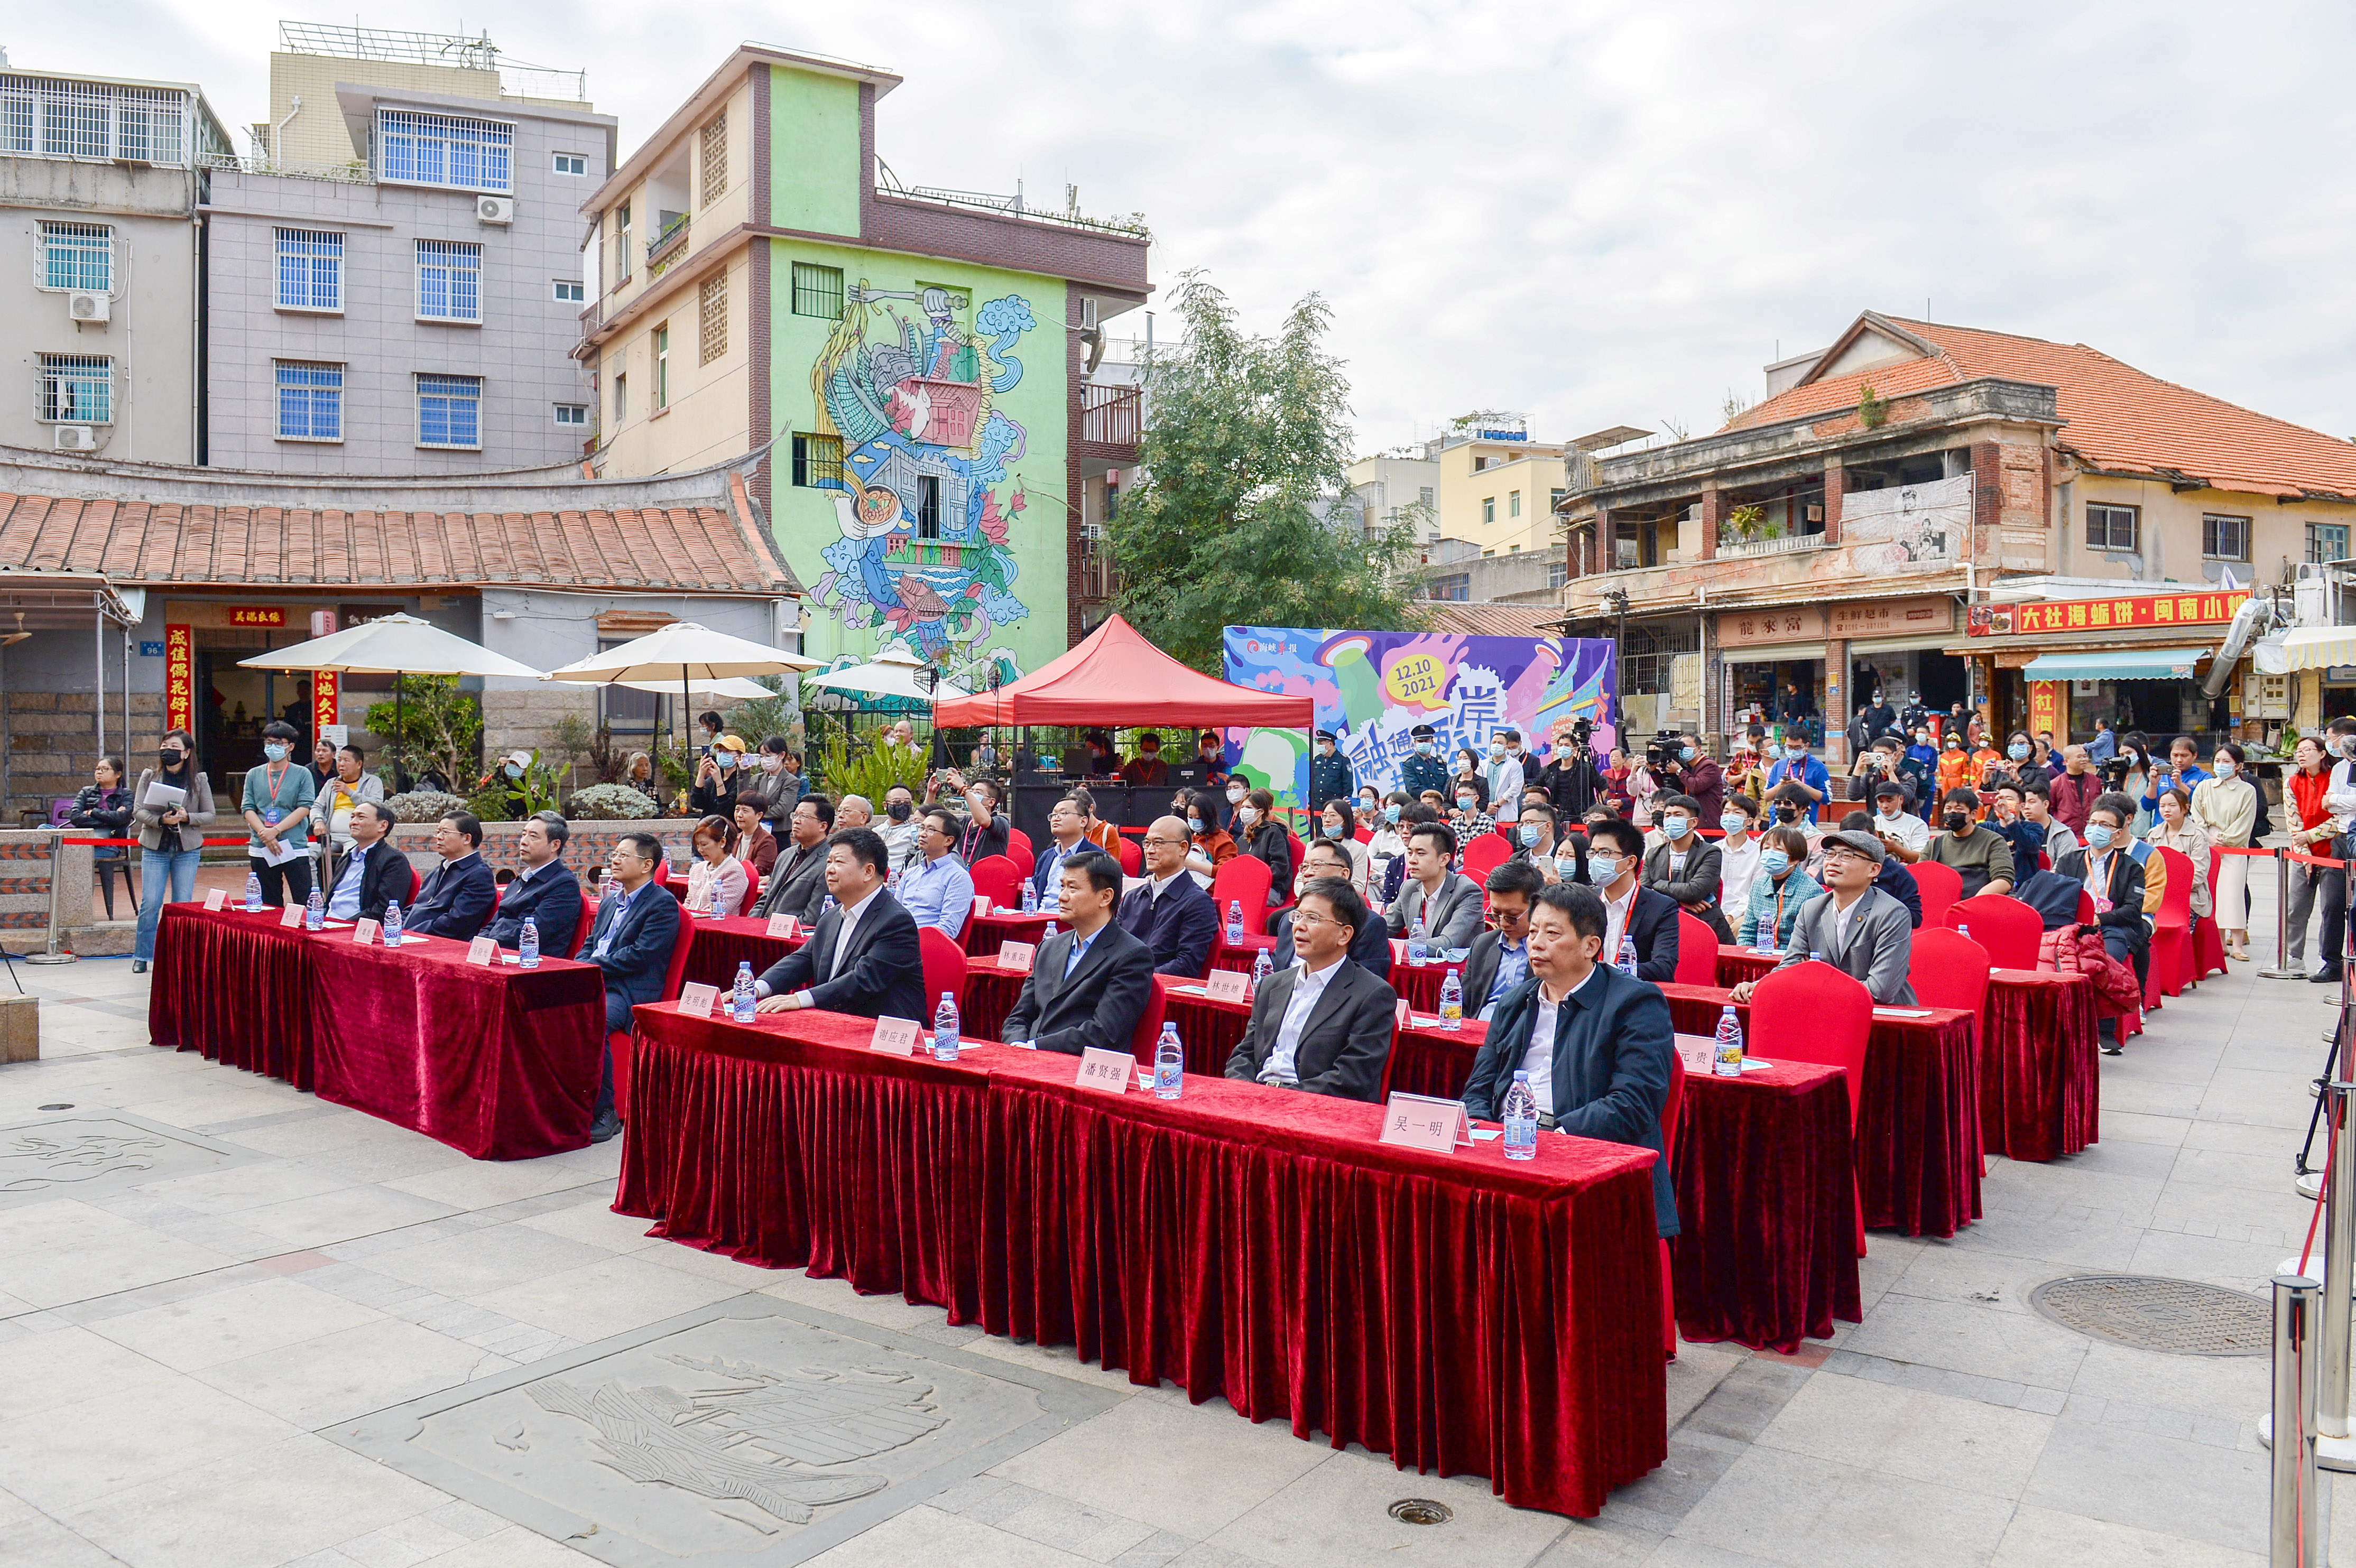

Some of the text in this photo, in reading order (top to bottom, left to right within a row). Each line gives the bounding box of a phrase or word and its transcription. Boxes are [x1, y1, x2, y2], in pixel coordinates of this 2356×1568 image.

[1396, 659, 1431, 681] 12.10
[1402, 675, 1436, 697] 2021
[879, 1029, 908, 1045] 谢应君
[1085, 1062, 1121, 1081] 潘贤强
[1393, 1116, 1443, 1136] 吴一明
